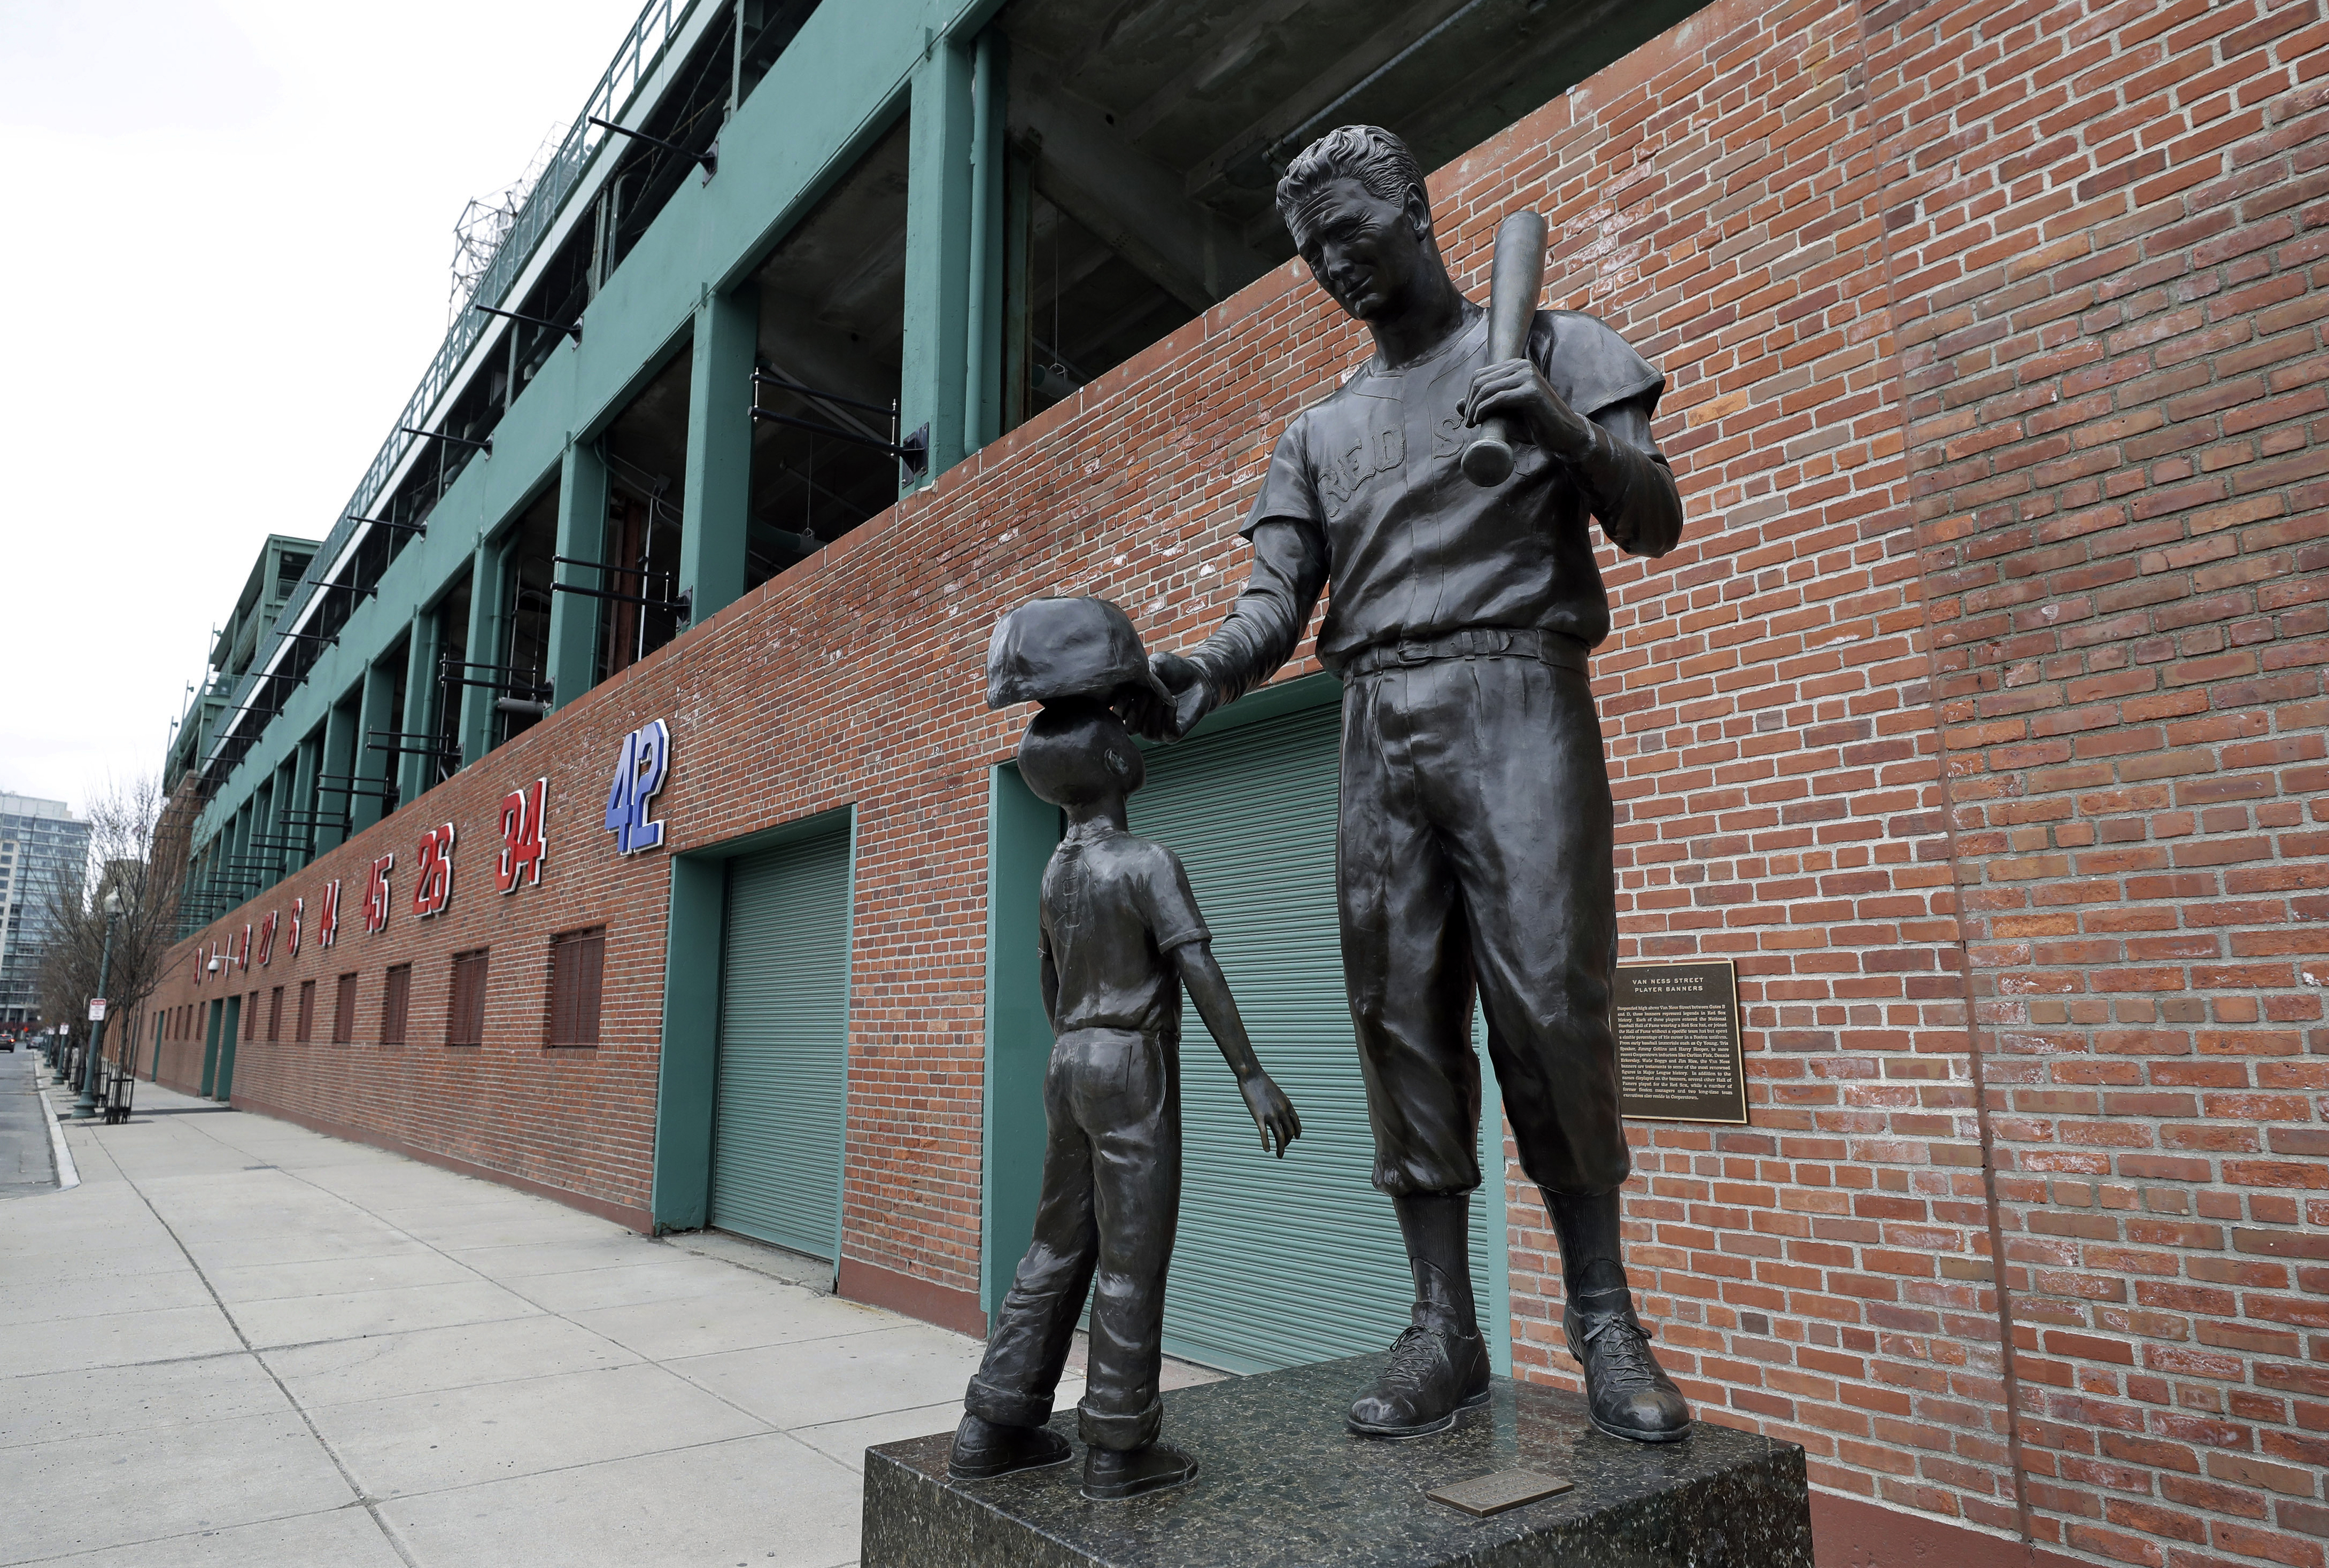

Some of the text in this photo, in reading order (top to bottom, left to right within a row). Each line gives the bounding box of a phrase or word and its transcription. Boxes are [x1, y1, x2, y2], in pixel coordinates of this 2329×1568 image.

[1317, 423, 1406, 517] RED
[605, 718, 669, 856] 42
[413, 822, 454, 919] 26
[495, 777, 548, 895] 34
[288, 897, 304, 956] 6
[361, 852, 393, 934] 45
